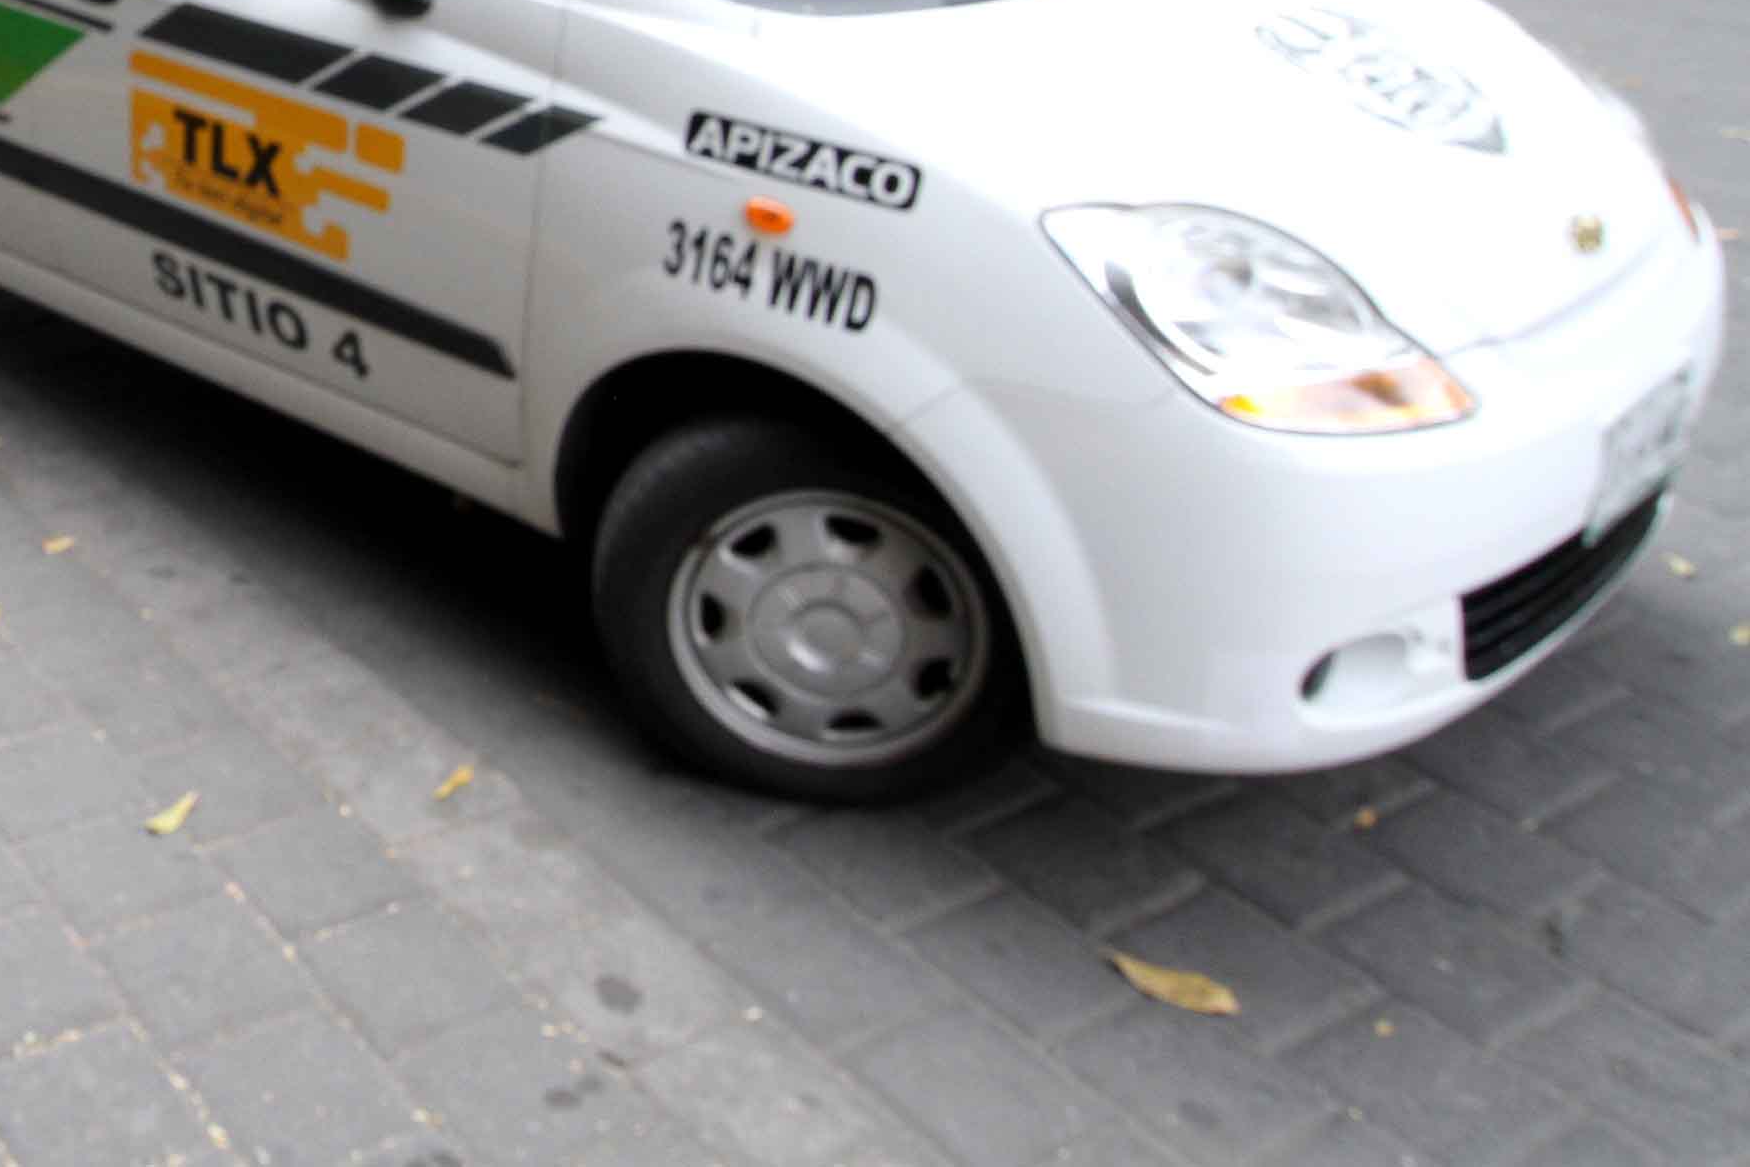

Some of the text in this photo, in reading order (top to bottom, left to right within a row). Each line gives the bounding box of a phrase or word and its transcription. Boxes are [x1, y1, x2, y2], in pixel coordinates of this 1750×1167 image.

[173, 106, 281, 198] TLX
[687, 115, 918, 208] APIZACO
[153, 251, 369, 379] SITIO 4
[663, 219, 879, 332] 3164 WWD
